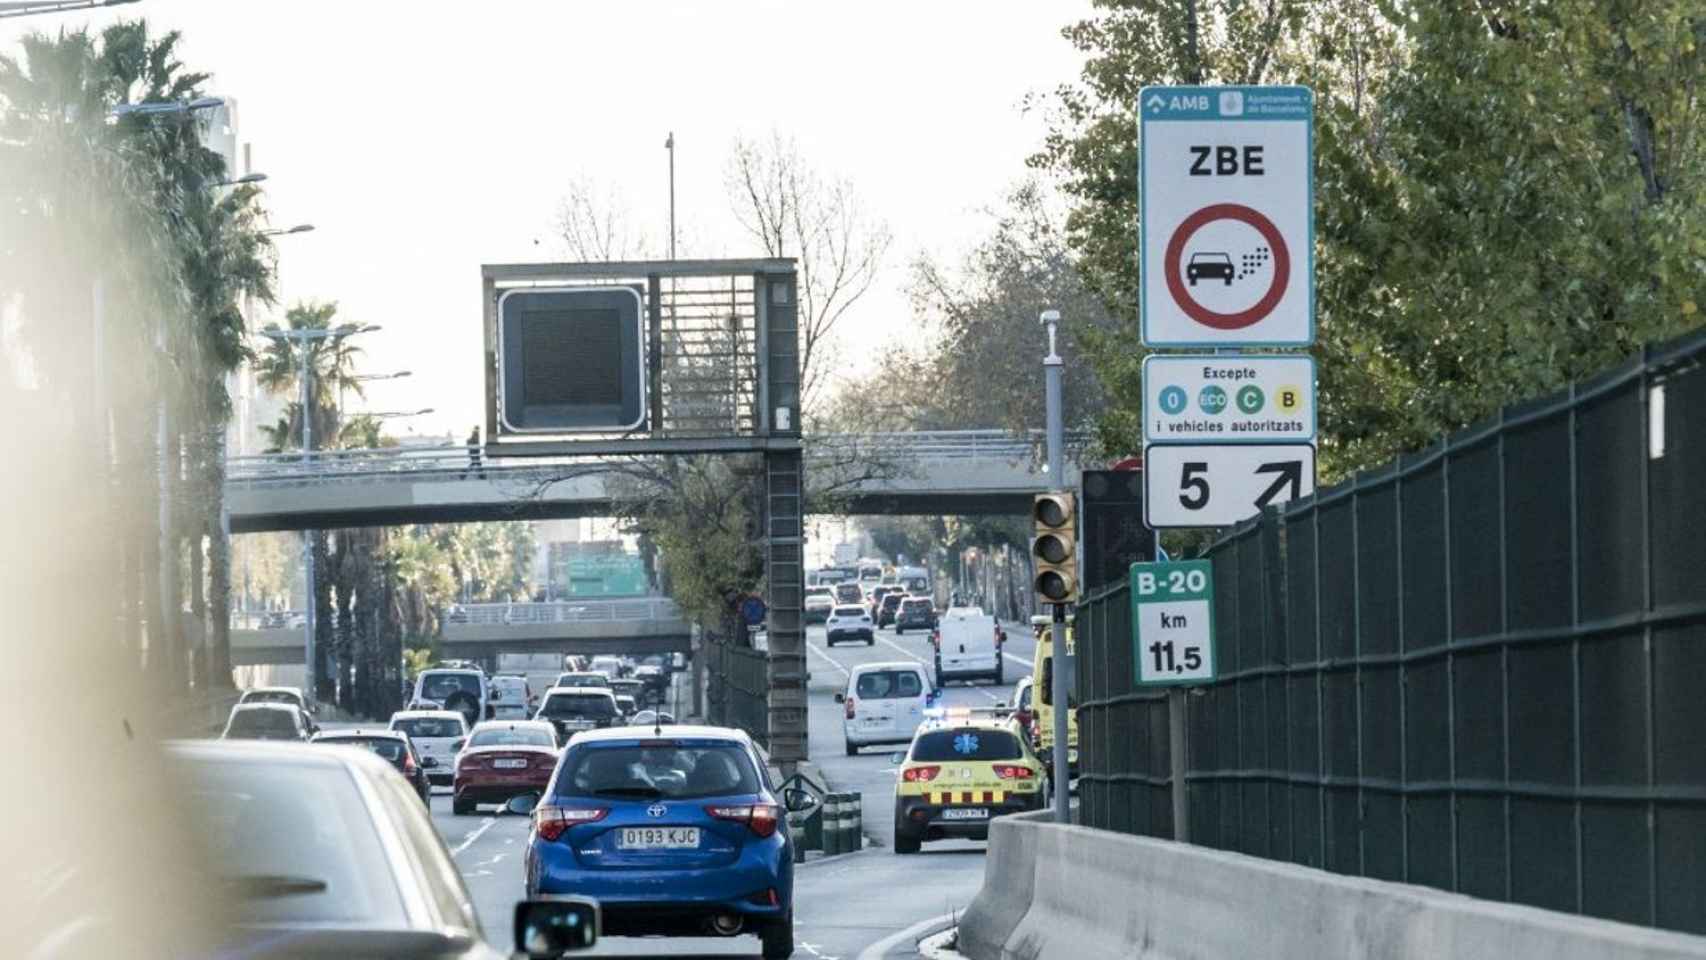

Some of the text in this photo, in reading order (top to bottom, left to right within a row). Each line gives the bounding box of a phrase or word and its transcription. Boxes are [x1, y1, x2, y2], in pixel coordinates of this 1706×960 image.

[1169, 96, 1209, 111] AMB
[1189, 145, 1265, 176] ZBE
[1203, 367, 1257, 381] Excepte
[1200, 393, 1226, 406] ECO
[1243, 391, 1258, 408] C
[1282, 391, 1296, 408] B
[1156, 420, 1304, 432] i vehicles autoritzats
[1178, 461, 1210, 511] 5
[1138, 570, 1206, 595] B-20
[1160, 612, 1187, 629] km
[1149, 640, 1203, 675] 11,5
[627, 829, 697, 845] 0193 KJC
